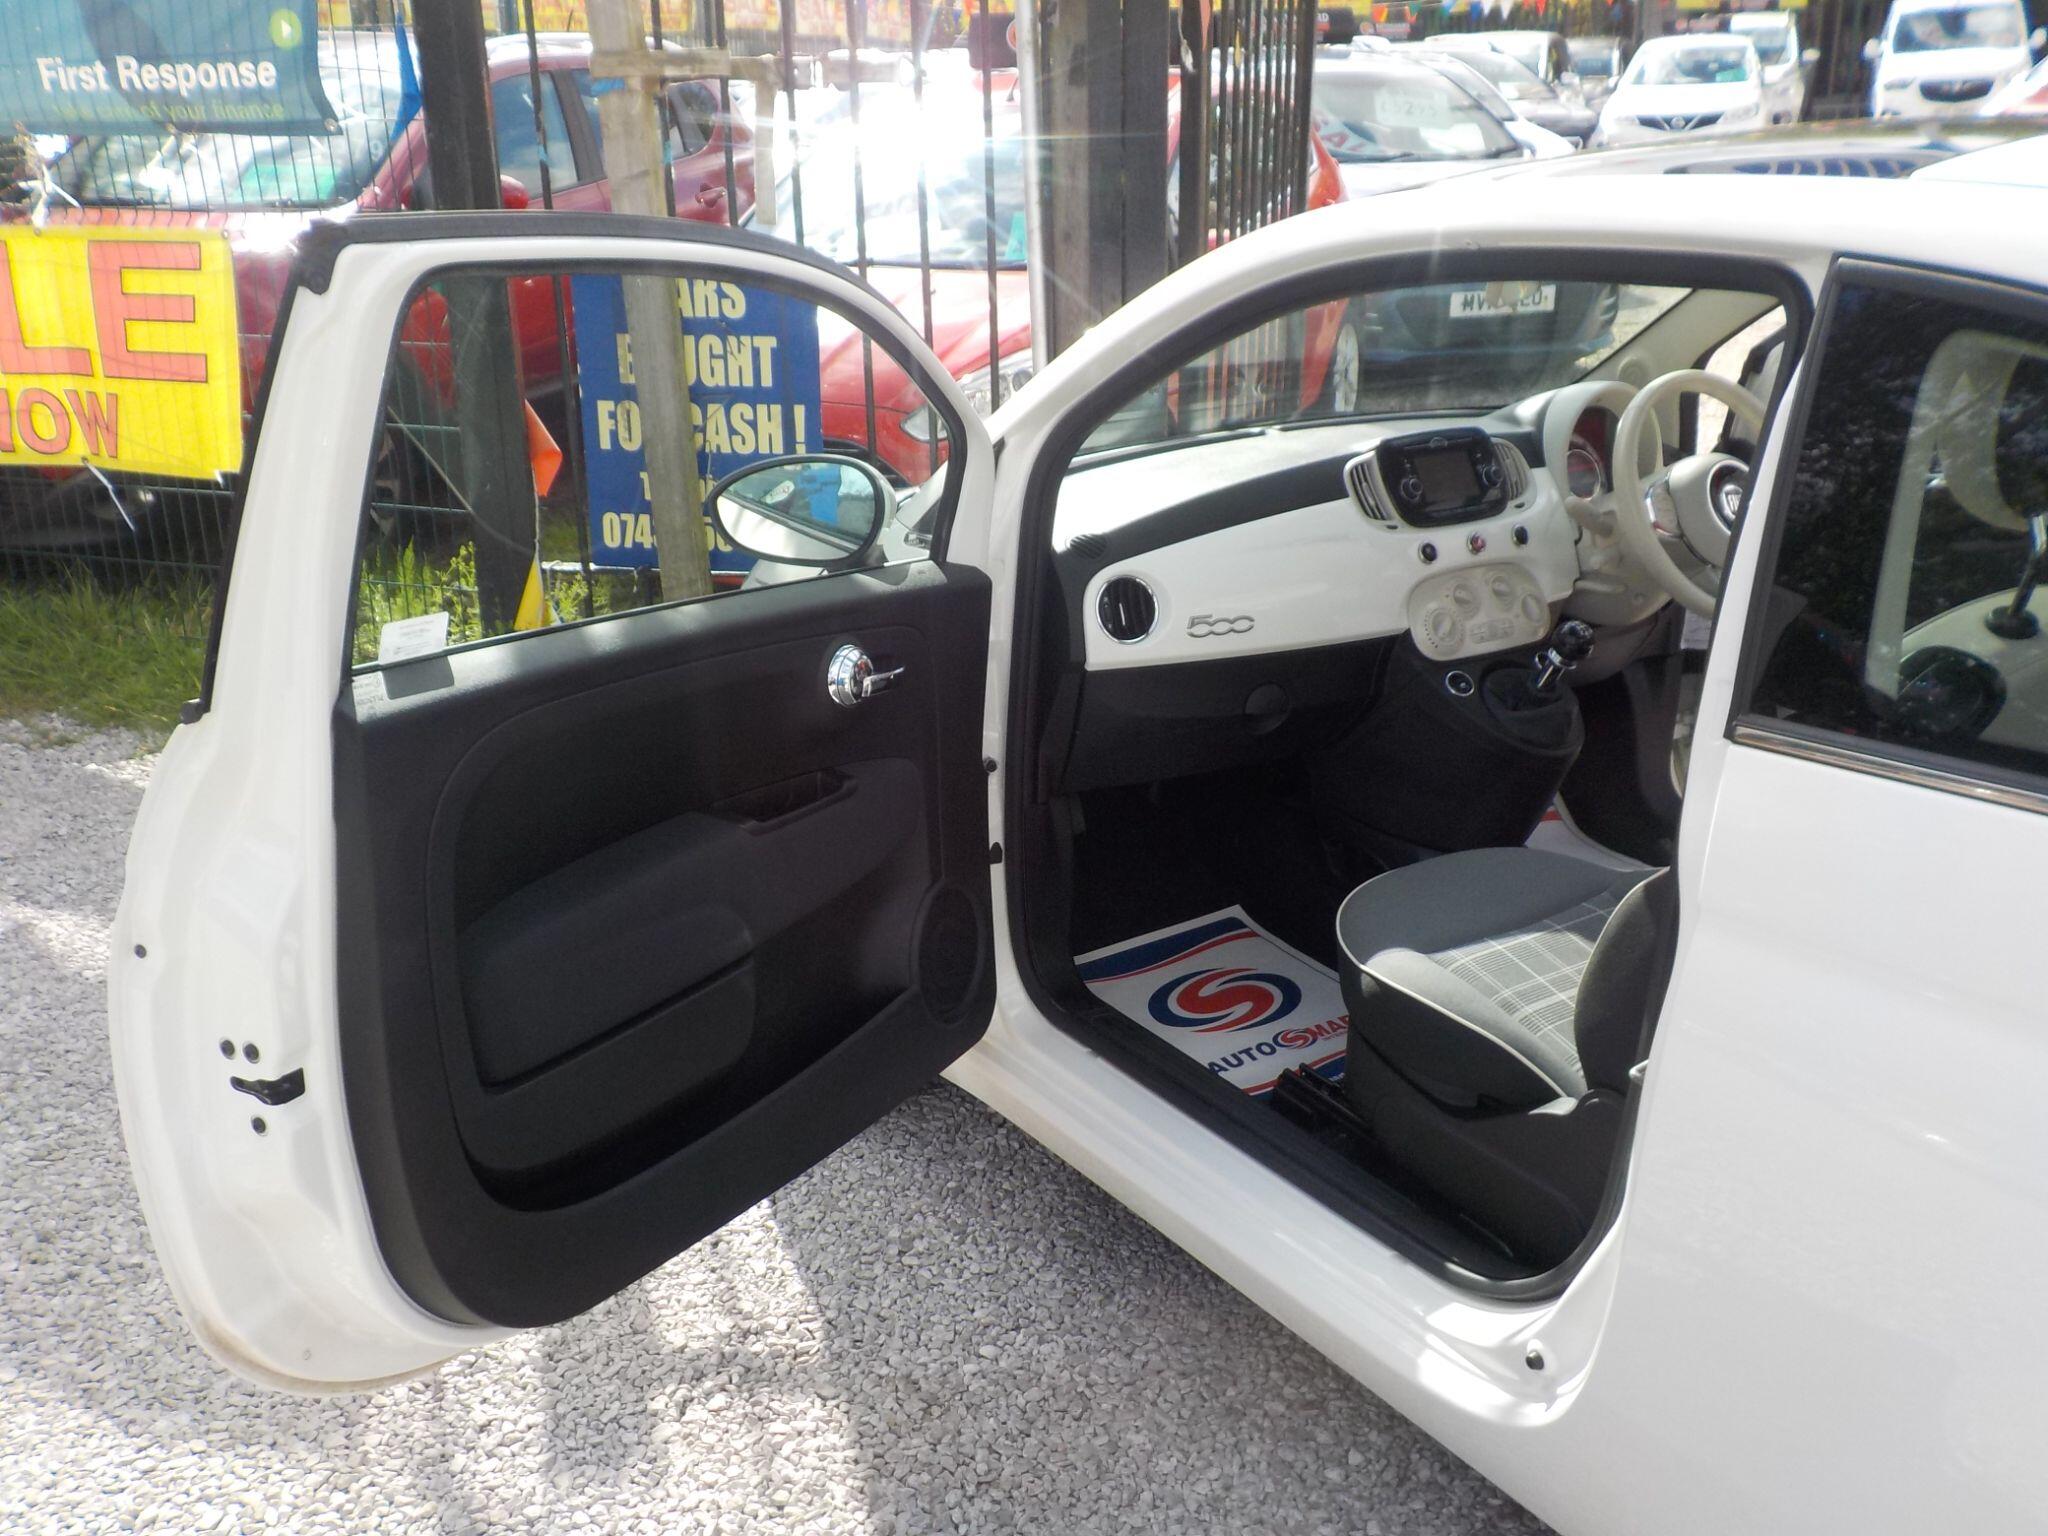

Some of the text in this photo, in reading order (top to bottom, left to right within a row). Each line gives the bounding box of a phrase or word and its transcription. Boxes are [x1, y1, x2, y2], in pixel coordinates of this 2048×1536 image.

[36, 55, 277, 97] First Response
[166, 105, 206, 125] your
[676, 277, 746, 319] ARS
[616, 333, 777, 388] BGHT
[597, 400, 642, 451] FO
[1186, 614, 1255, 638] 500
